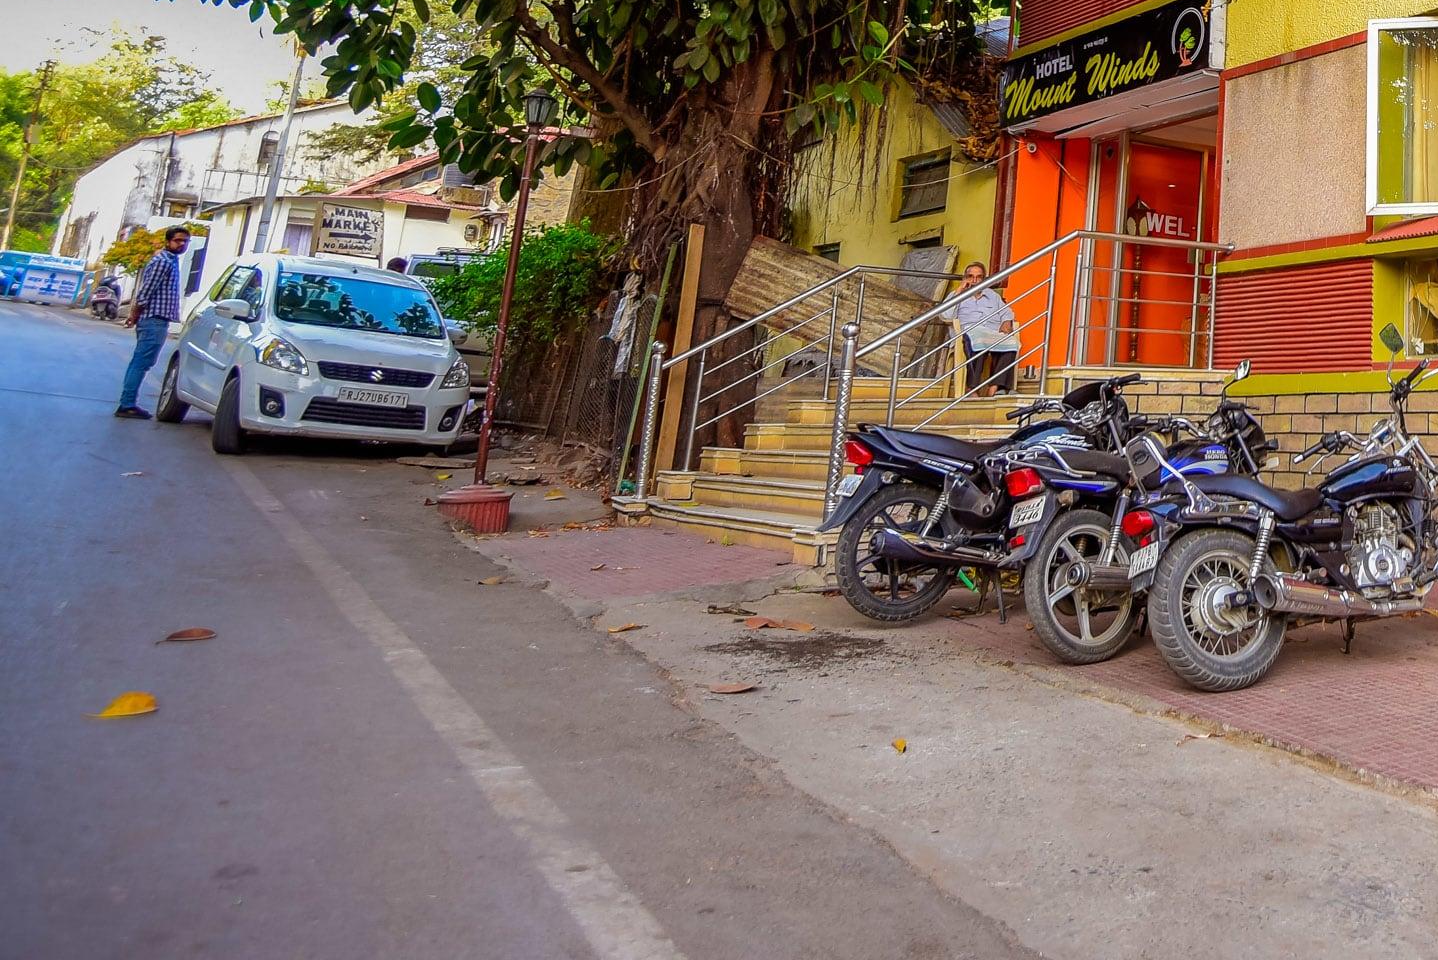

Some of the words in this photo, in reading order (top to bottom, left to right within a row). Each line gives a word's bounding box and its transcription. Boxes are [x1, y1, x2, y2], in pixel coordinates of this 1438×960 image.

[1005, 70, 1077, 120] Mount
[1085, 40, 1161, 96] Winds
[1036, 54, 1074, 80] HOTEL
[322, 218, 379, 233] MARKET
[335, 207, 369, 220] MAIN
[1146, 211, 1190, 238] WEL
